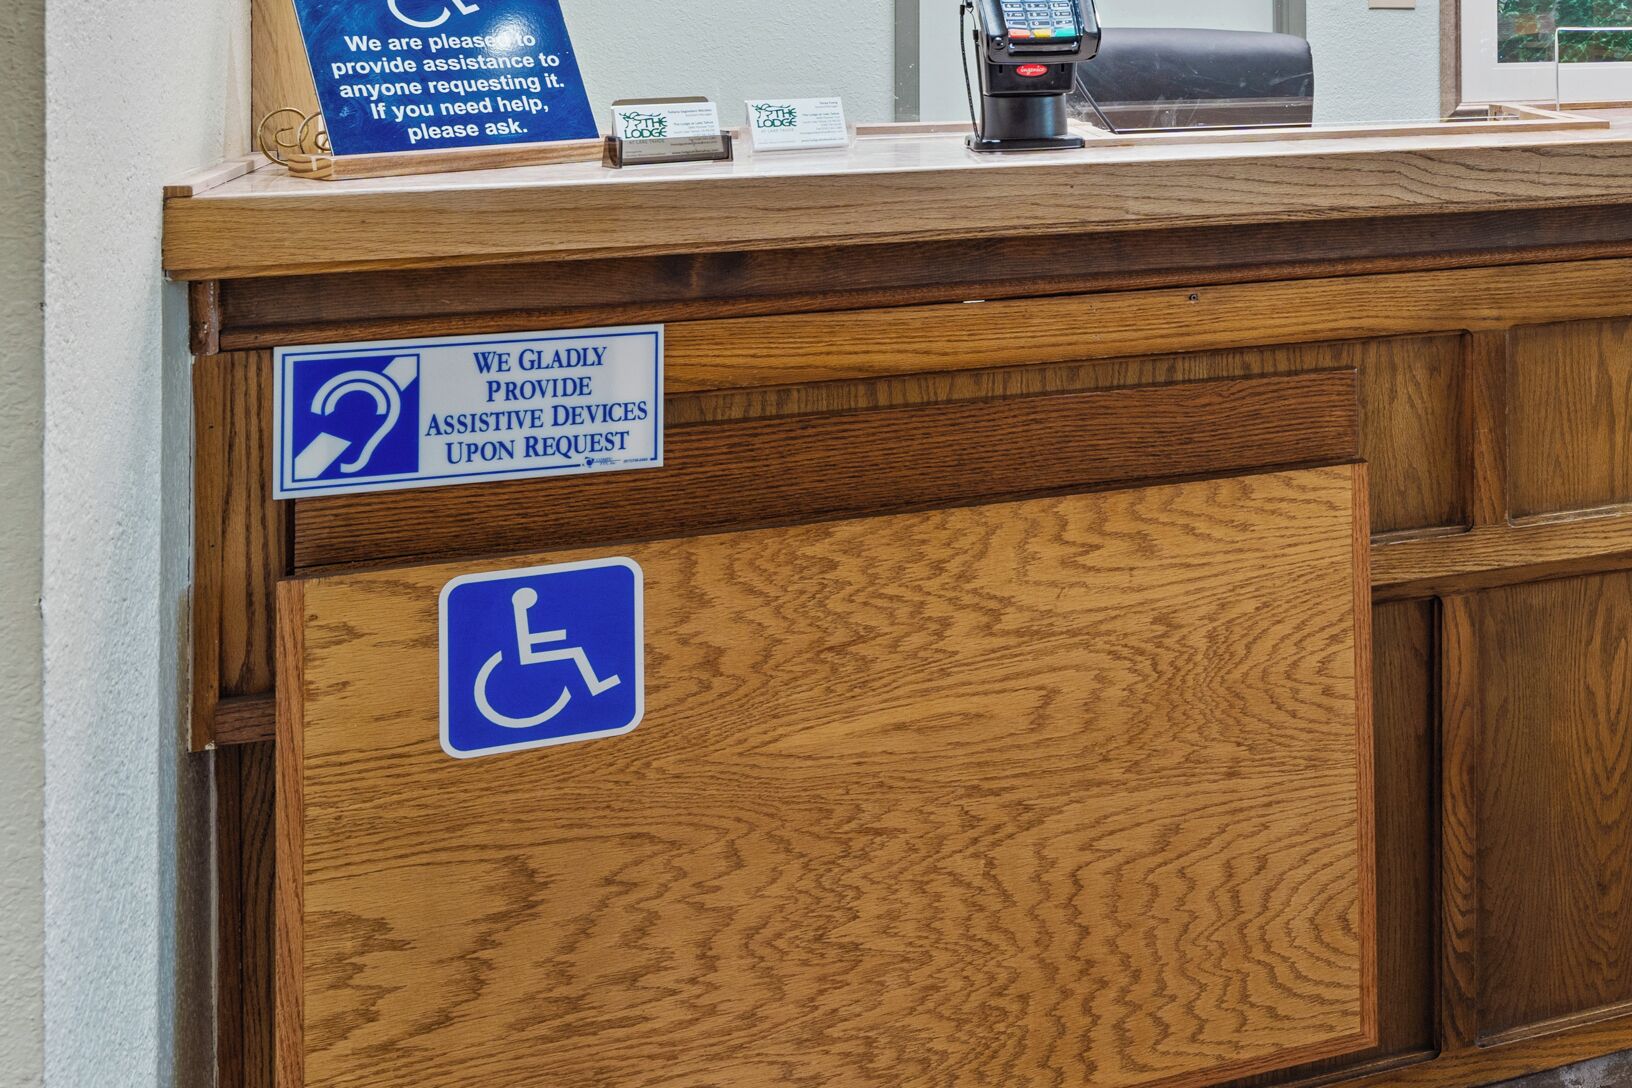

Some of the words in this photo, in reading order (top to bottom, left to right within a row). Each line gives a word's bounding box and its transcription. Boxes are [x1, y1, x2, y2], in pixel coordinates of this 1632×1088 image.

[344, 35, 382, 52] We
[388, 36, 423, 51] are
[428, 33, 512, 52] please
[517, 34, 536, 49] to
[331, 57, 417, 79] provide
[423, 54, 535, 72] assistance
[540, 53, 560, 68] to
[339, 81, 422, 100] anyone
[427, 74, 541, 95] requesting
[546, 73, 565, 89] it.
[370, 103, 386, 119] If
[392, 103, 434, 122] you
[440, 98, 493, 115] need
[497, 95, 549, 114] help,
[407, 122, 479, 144] please
[485, 118, 528, 136] ask.
[624, 127, 667, 139] LODGE
[757, 118, 797, 128] LODGE
[473, 351, 512, 374] WE
[518, 346, 607, 372] GLADLY
[486, 376, 593, 403] PROVIDE
[424, 408, 544, 437] ASSISTIVE
[551, 400, 649, 427] DEVICES
[445, 440, 516, 465] UPON
[523, 430, 631, 460] REQUEST
